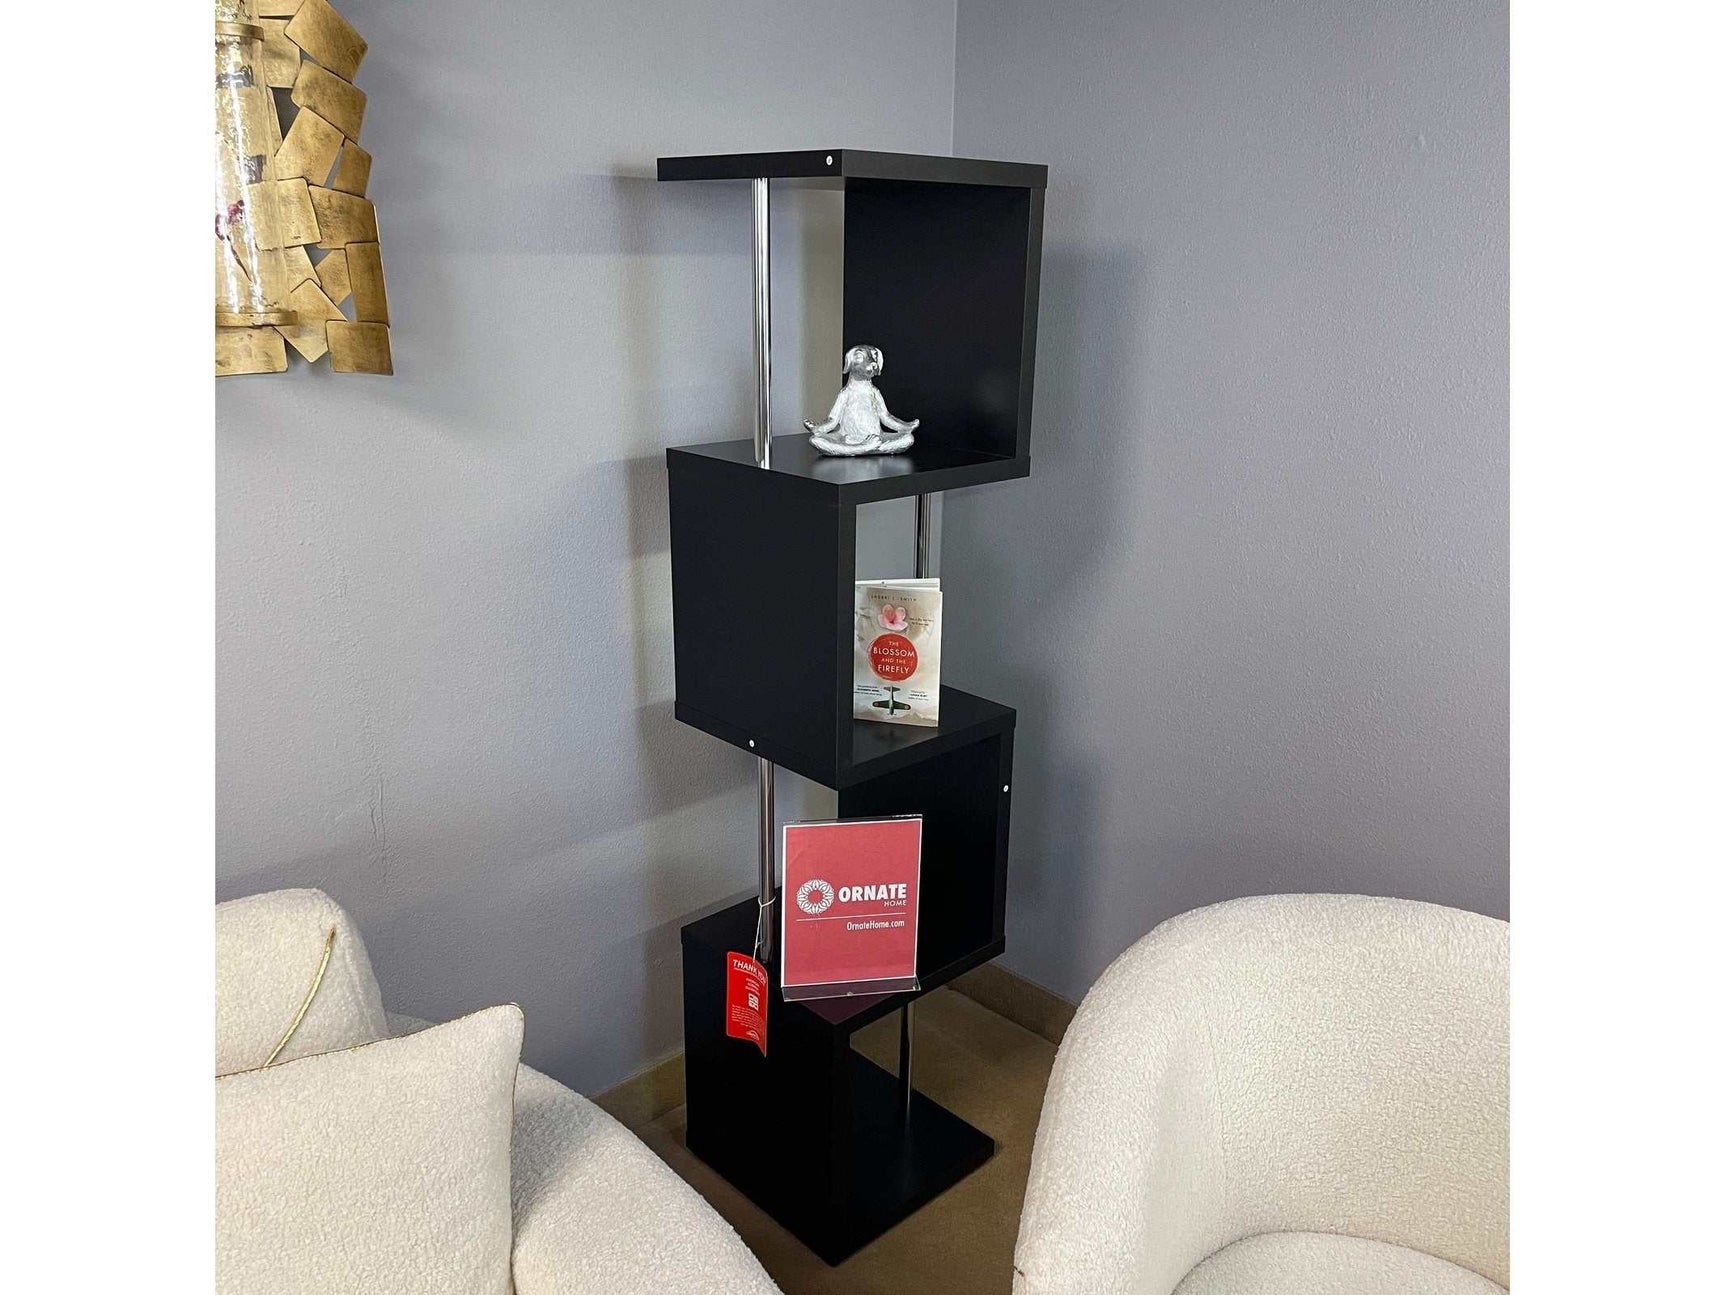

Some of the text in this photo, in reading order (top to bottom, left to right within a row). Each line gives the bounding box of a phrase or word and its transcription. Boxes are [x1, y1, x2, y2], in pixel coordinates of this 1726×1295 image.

[873, 647, 915, 657] BLOSSOM
[877, 664, 910, 674] FIREFLY
[838, 883, 907, 902] ORNATE
[846, 920, 905, 931] OrnateHome.com
[732, 959, 758, 975] THANK
